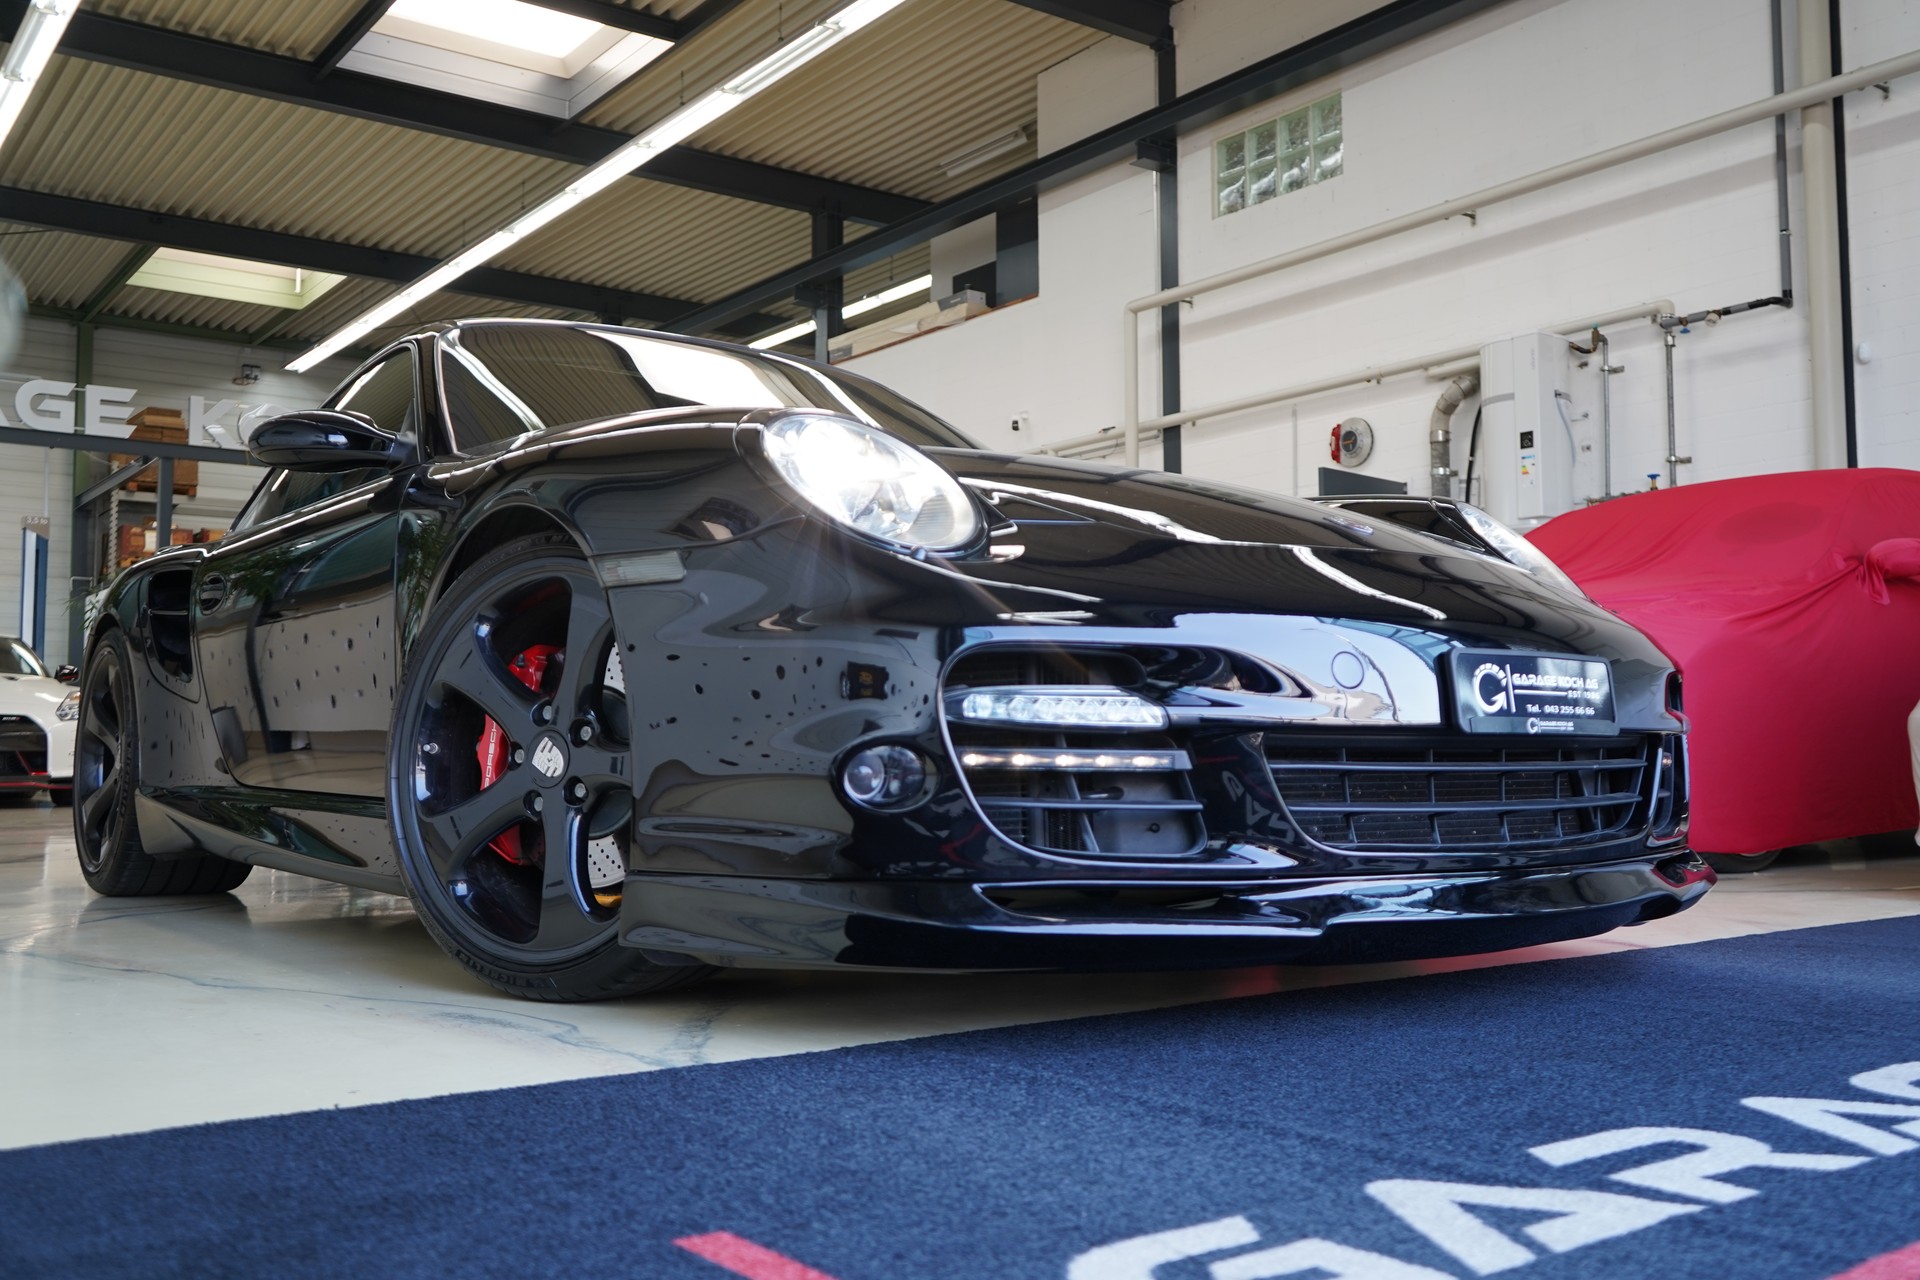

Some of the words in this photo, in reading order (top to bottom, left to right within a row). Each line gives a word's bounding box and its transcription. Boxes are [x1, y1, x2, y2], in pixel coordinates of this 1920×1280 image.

[0, 379, 138, 439] GE
[1512, 673, 1557, 688] GARAGE
[1558, 676, 1584, 689] KOCH
[1585, 678, 1599, 690] AG
[1567, 690, 1581, 699] EST
[1526, 704, 1541, 713] Tel.
[1544, 705, 1559, 714] 043
[1560, 706, 1574, 715] 255
[1574, 706, 1585, 716] 66
[1585, 707, 1596, 716] 66
